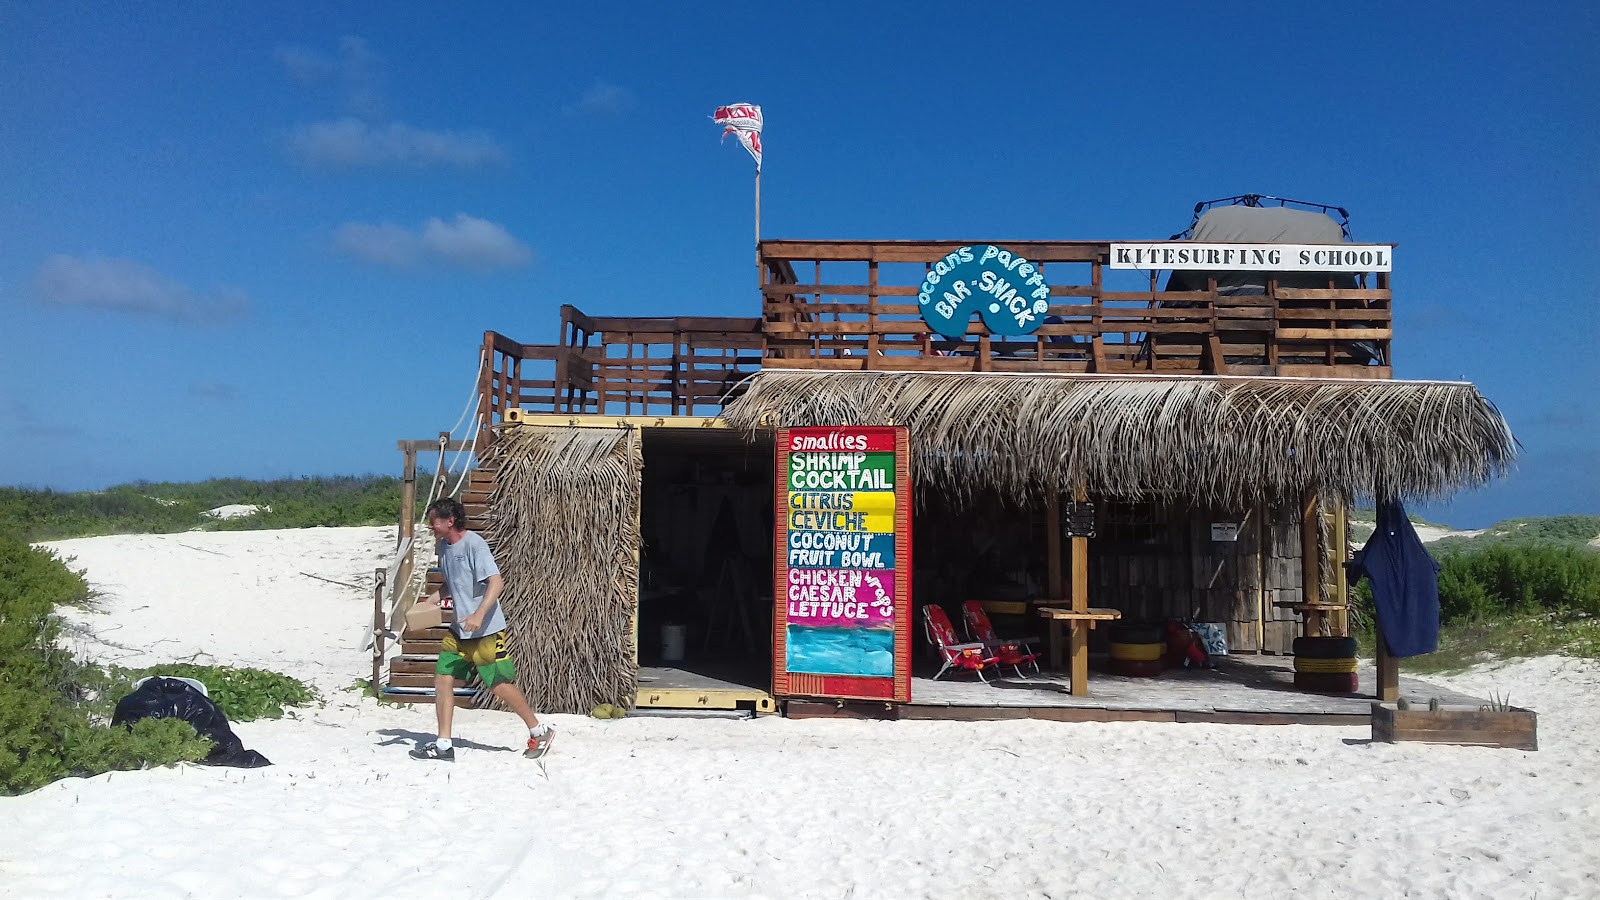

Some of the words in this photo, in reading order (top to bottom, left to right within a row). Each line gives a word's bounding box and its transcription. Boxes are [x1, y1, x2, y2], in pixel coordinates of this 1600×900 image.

[1117, 248, 1281, 265] KITESURFING
[1299, 249, 1389, 267] SCHOOL
[791, 452, 867, 471] SHRIMP
[791, 469, 893, 489] COCKTAIL
[790, 493, 854, 510] CITRUS
[792, 511, 868, 531] CEVICHE
[790, 532, 874, 551] COCONUT
[789, 549, 834, 566] FRUIT
[841, 551, 884, 568] BOWL
[789, 568, 862, 587] CHICKEN
[789, 585, 857, 602] CAESAR
[789, 601, 869, 619] LETTUCE
